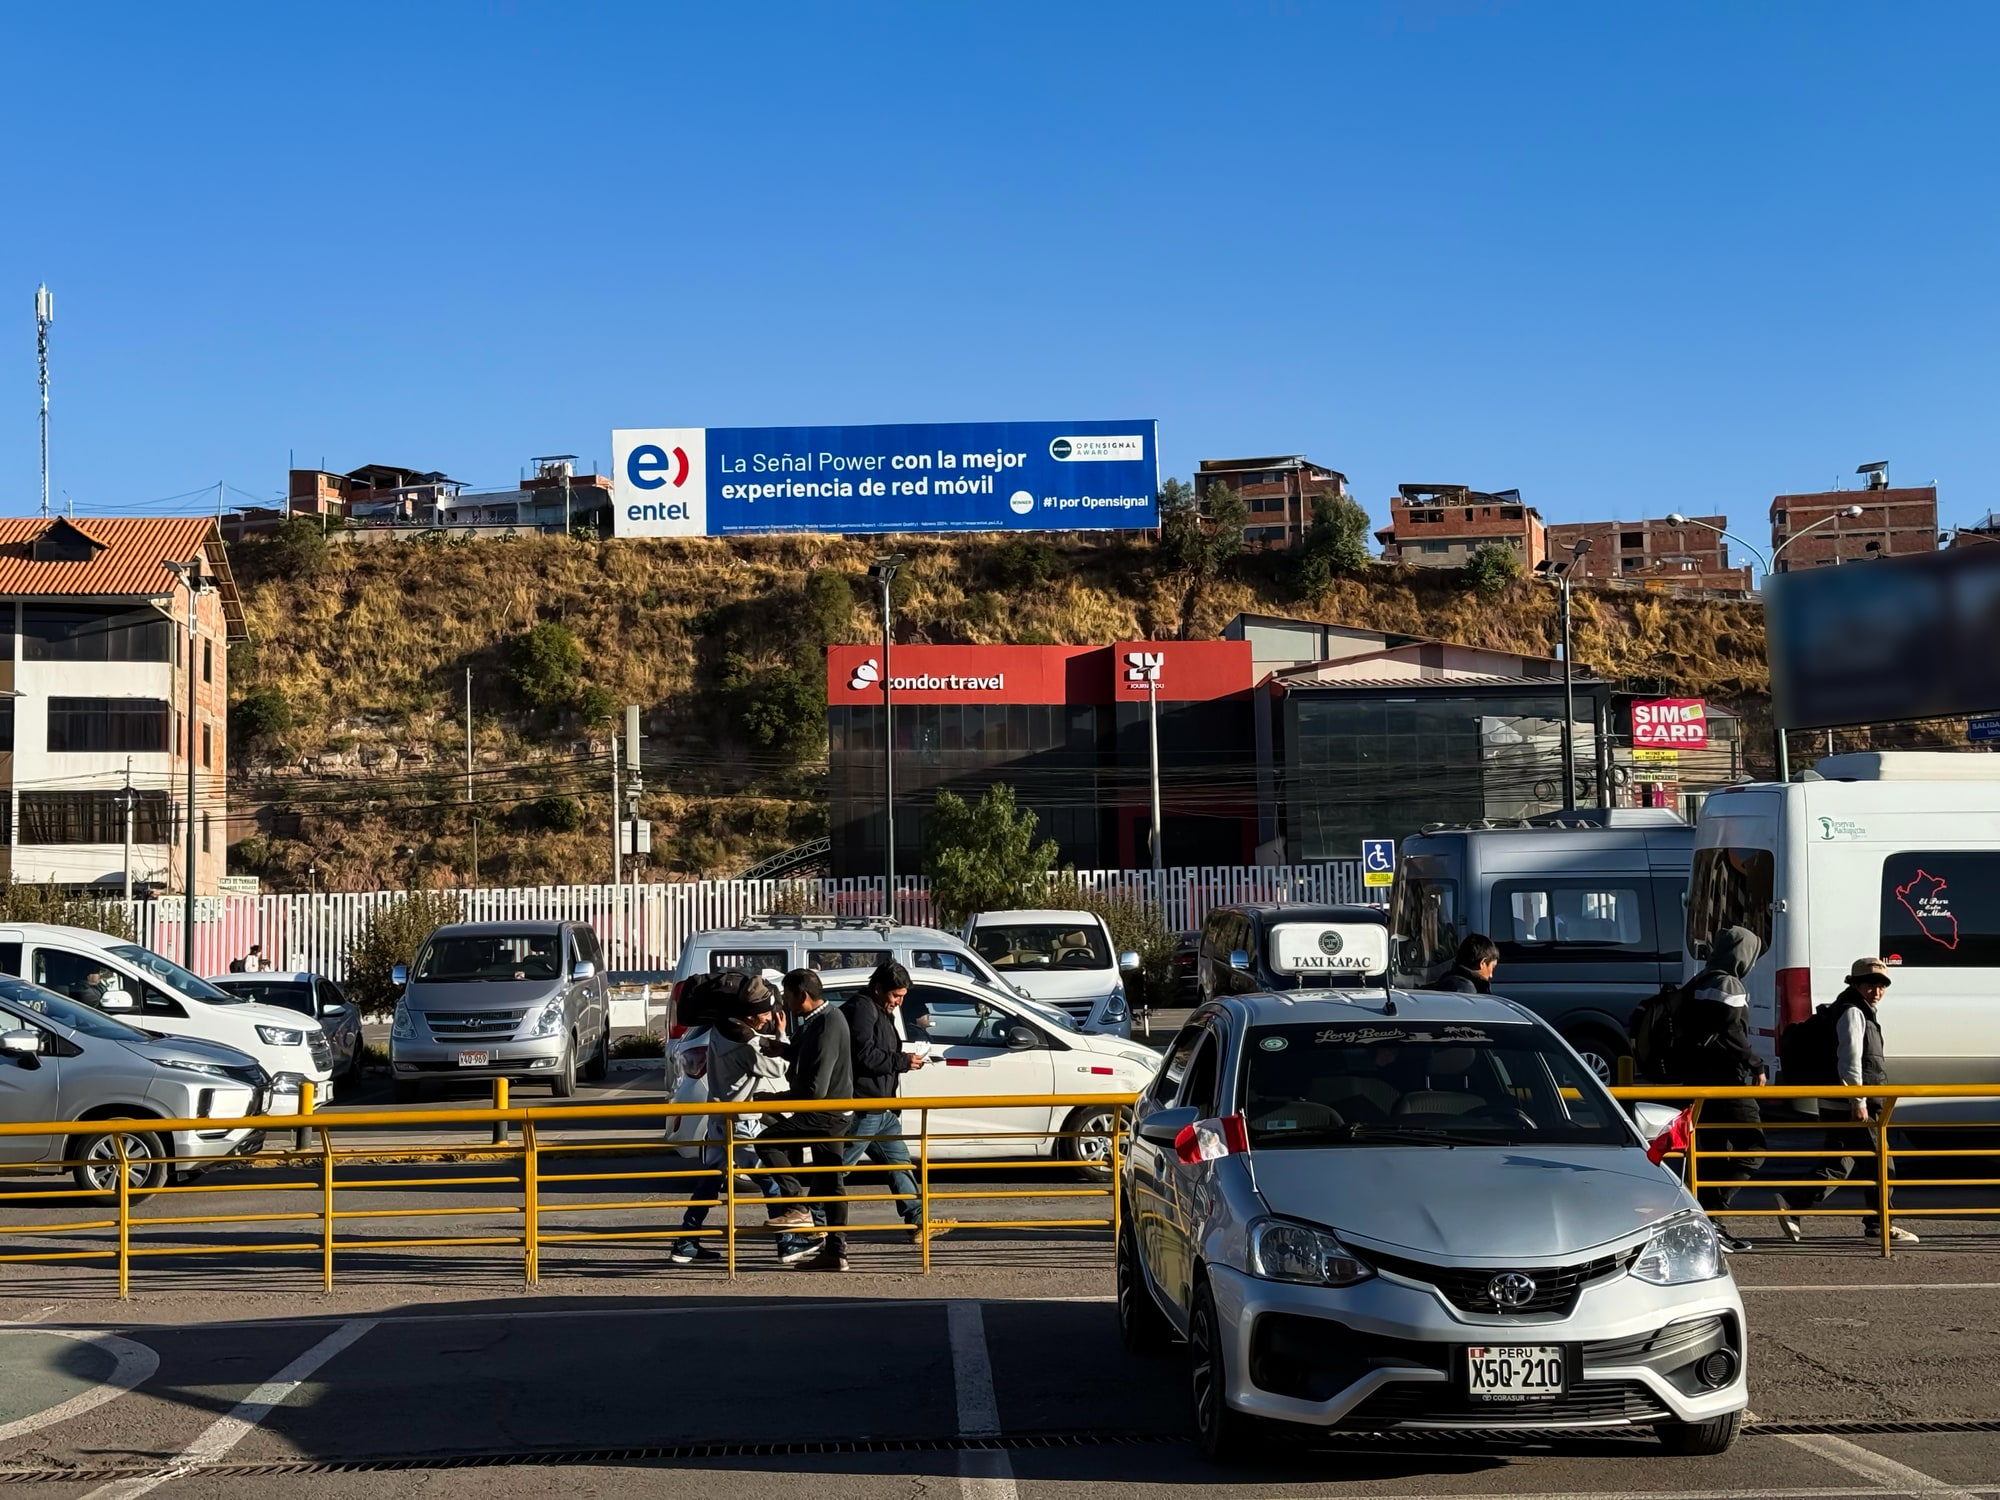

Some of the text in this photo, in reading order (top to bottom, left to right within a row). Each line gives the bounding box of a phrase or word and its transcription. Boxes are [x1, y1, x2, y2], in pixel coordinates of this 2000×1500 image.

[721, 448, 1027, 473] La Señal Power con la mejor
[721, 475, 993, 503] experiencia de red móvil
[627, 501, 690, 521] entel
[1043, 496, 1149, 509] #1 por Opensignal
[1635, 705, 1679, 723] SIM
[1636, 724, 1704, 742] CARD
[1292, 957, 1370, 967] TAXI KAPAC
[1315, 1027, 1405, 1043] Long Beach
[1498, 1348, 1533, 1358] PERU
[1472, 1359, 1561, 1388] X5Q-210
